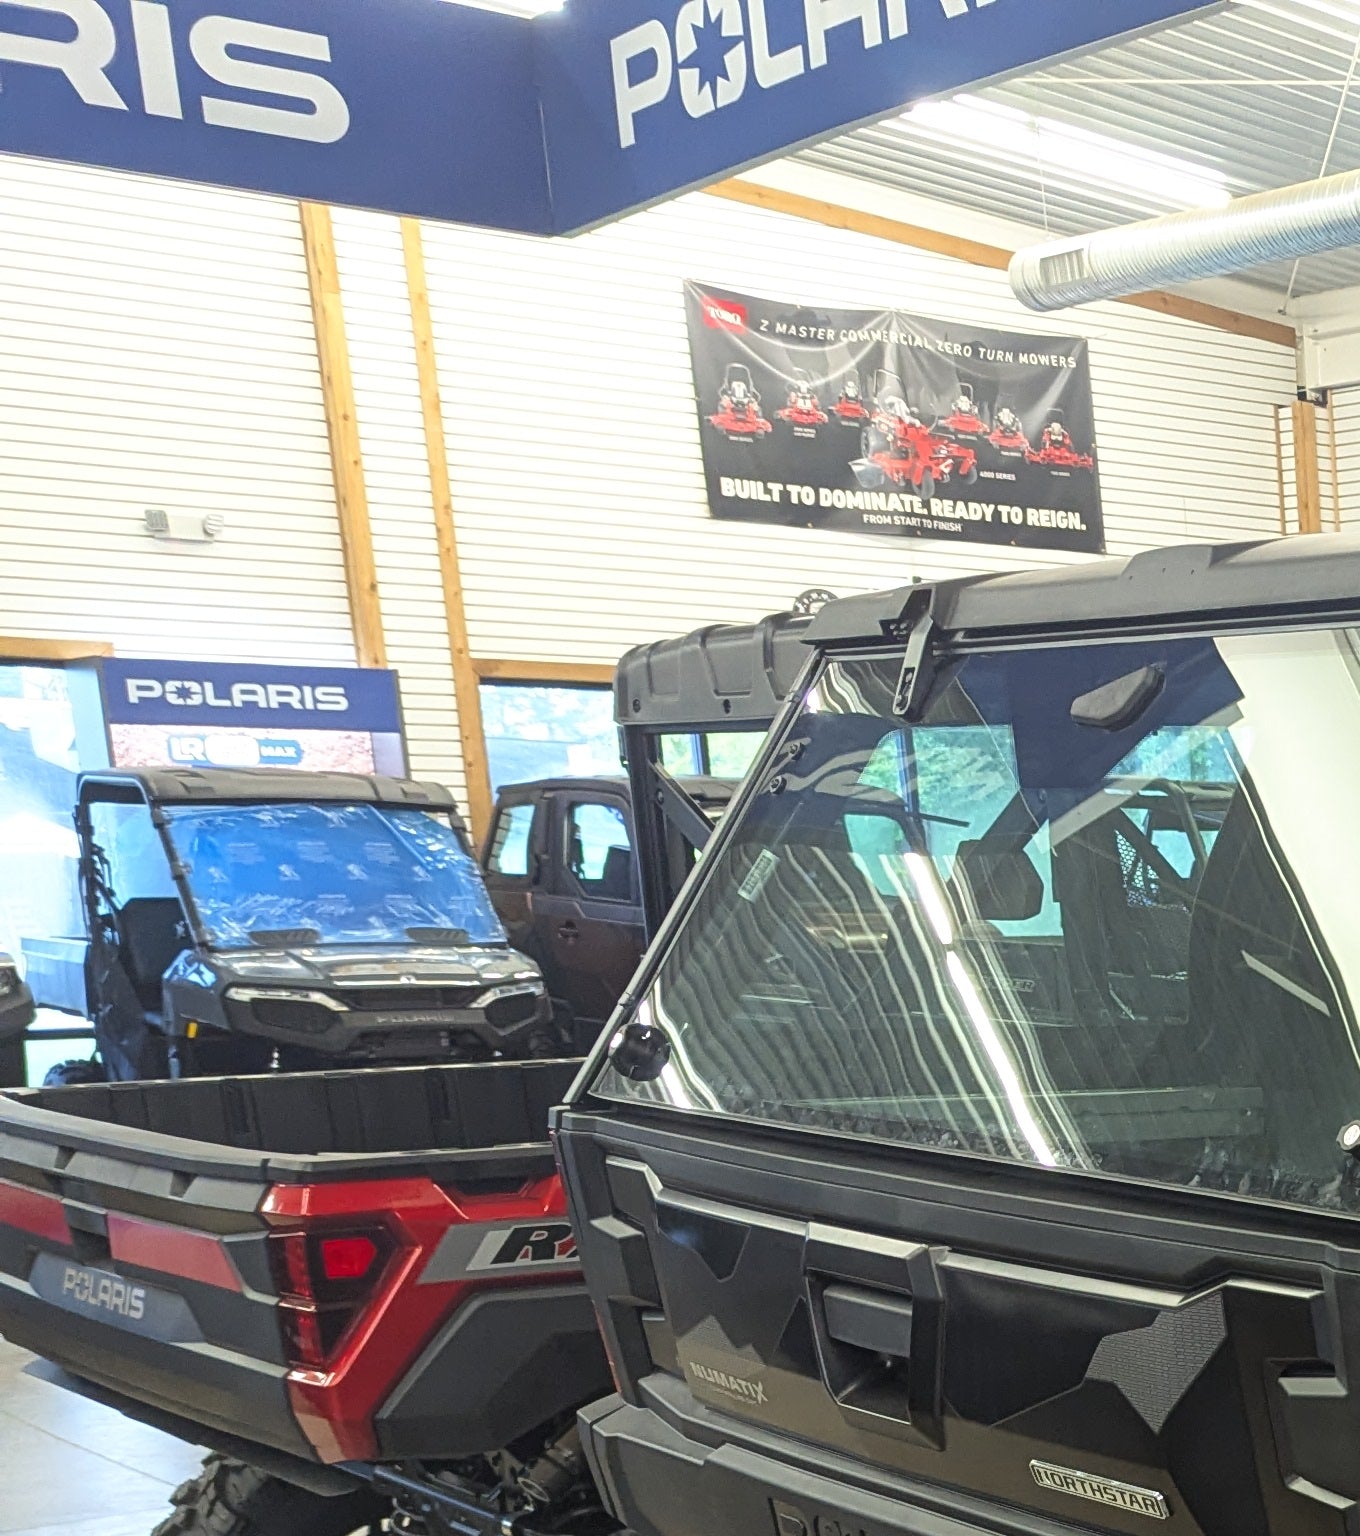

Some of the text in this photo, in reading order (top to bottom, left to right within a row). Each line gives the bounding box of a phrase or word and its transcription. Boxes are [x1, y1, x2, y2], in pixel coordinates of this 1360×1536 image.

[609, 0, 1003, 149] POLA
[759, 319, 1077, 369] Z MASTER COMMERCIAL ZERO TURN MOWERS
[719, 476, 1087, 531] BUILT TO DOMINATE. READY TO REIGN.
[862, 513, 962, 532] FROM START TO FINISH
[124, 678, 350, 712] POLARIS
[62, 1267, 146, 1320] POLARIS
[1036, 1468, 1158, 1514] NORTHSTAR
